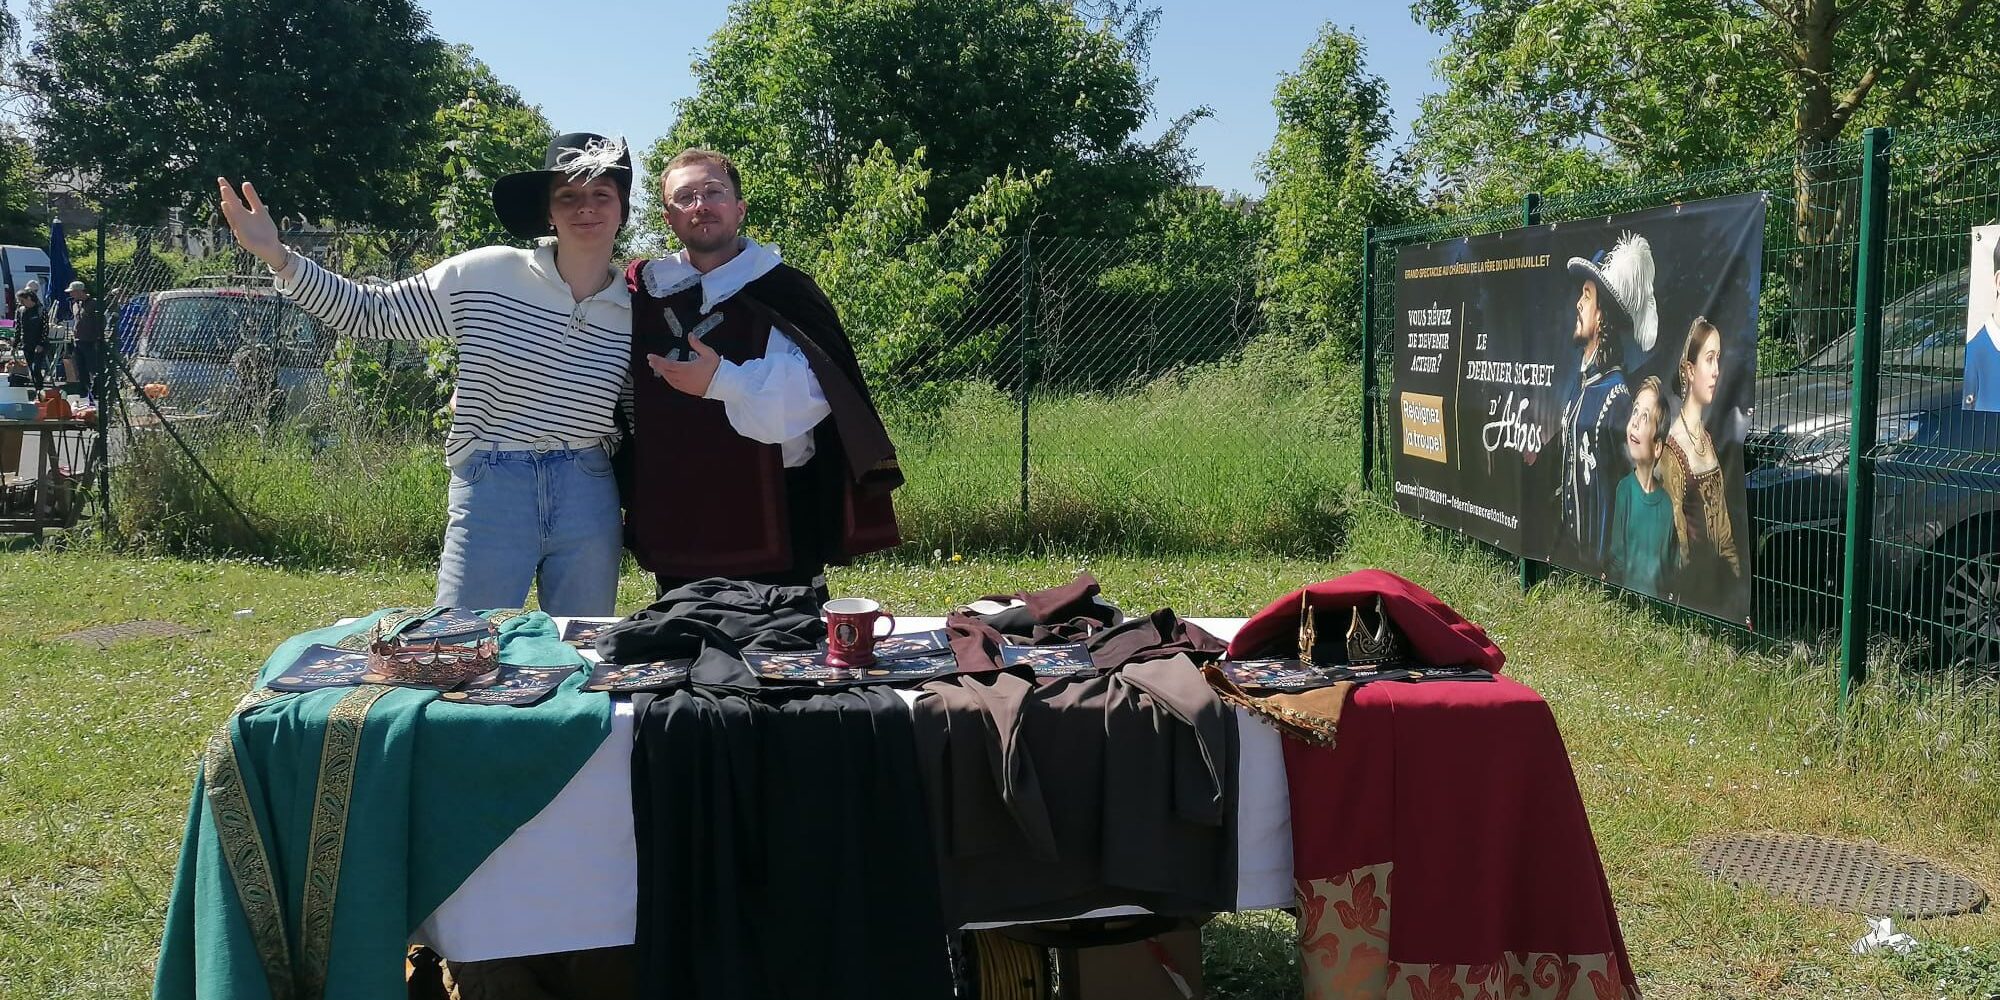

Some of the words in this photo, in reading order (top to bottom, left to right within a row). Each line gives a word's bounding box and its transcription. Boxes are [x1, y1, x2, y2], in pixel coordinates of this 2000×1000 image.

[1470, 262, 1477, 273] DE
[1477, 261, 1484, 273] LA
[1496, 259, 1503, 271] DU
[1508, 257, 1516, 270] AU
[1520, 254, 1551, 268] JUILLET
[1407, 309, 1427, 327] VOUS
[1427, 300, 1452, 326] RÊVEZ
[1407, 332, 1417, 348] DE
[1418, 332, 1450, 350] DEVENIR
[1475, 333, 1488, 350] LE
[1466, 360, 1512, 384] DERNIER
[1514, 362, 1555, 387] SECRET
[1402, 400, 1440, 426] Rejoignez
